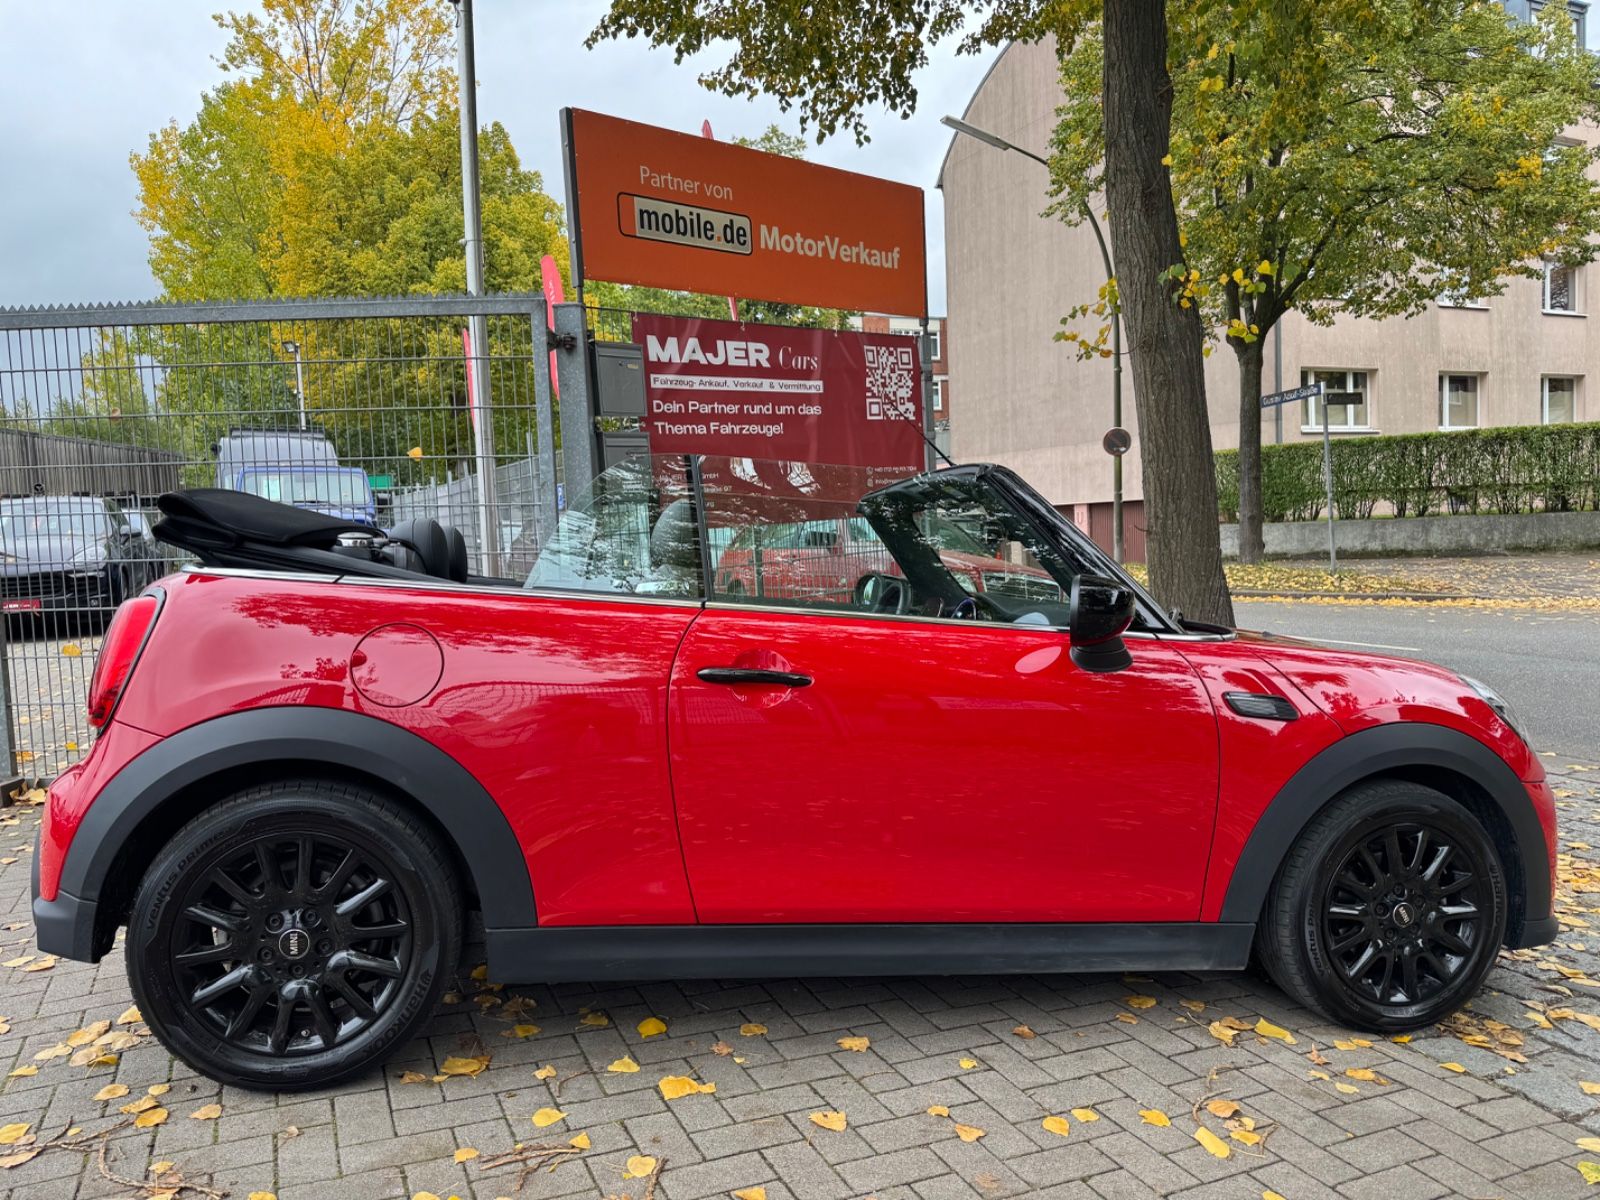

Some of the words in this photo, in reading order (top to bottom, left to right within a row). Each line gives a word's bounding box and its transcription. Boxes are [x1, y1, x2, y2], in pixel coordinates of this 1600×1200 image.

[639, 165, 700, 194] Partner
[704, 183, 733, 201] von
[639, 207, 748, 247] mobile.de
[760, 224, 900, 269] MotorVerkauf
[646, 334, 771, 368] MAJER
[779, 345, 818, 370] Cars
[733, 380, 763, 389] Verkauf
[769, 381, 775, 389] &
[778, 382, 821, 392] Vermittlung
[652, 400, 685, 413] Dein
[688, 401, 740, 414] Partner
[743, 402, 772, 415] rund
[775, 405, 795, 415] um
[798, 403, 822, 415] das
[654, 422, 707, 435] Thema
[710, 422, 784, 437] Fahrzeuge!
[290, 933, 299, 955] MINI
